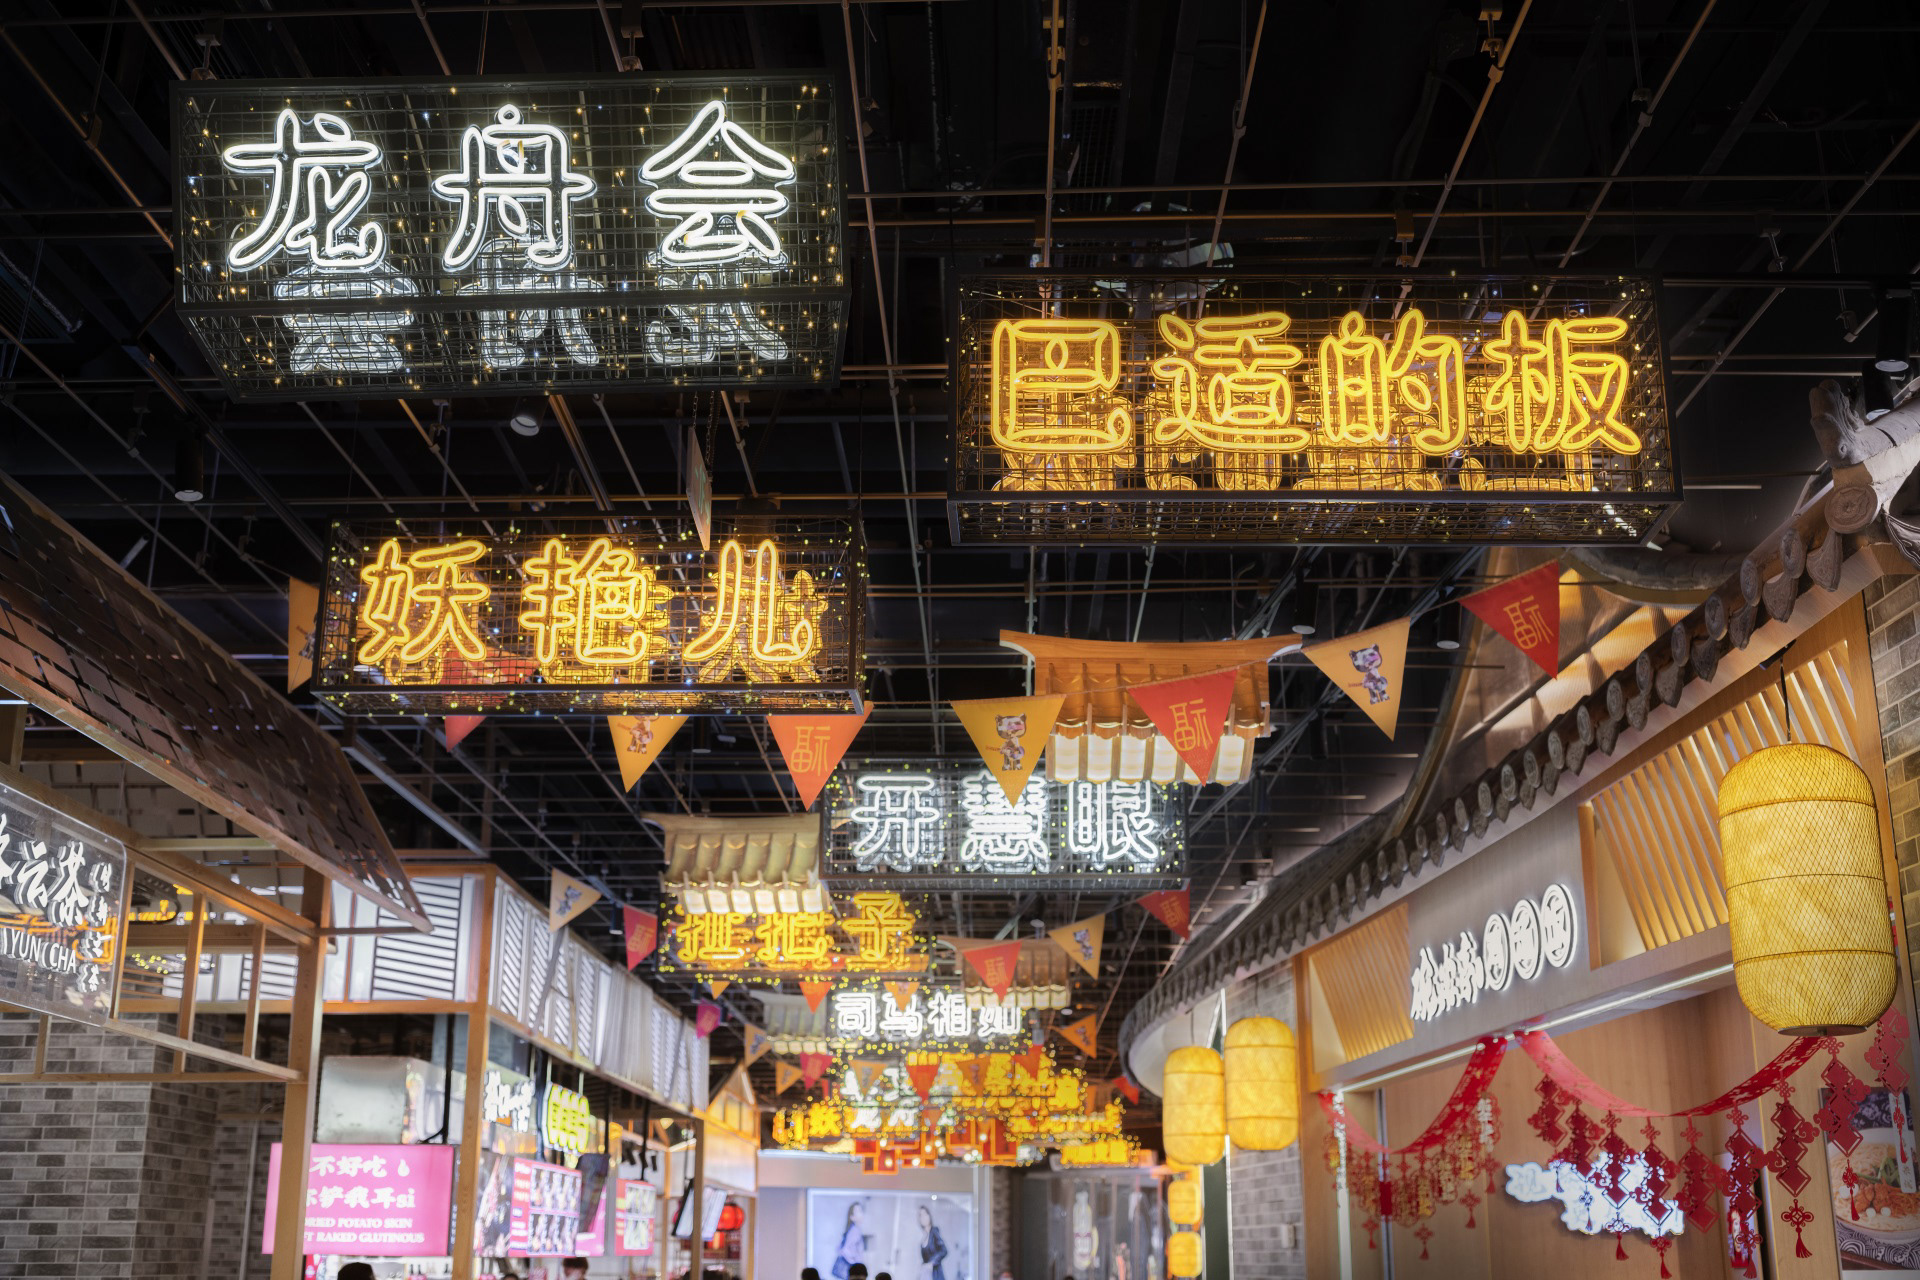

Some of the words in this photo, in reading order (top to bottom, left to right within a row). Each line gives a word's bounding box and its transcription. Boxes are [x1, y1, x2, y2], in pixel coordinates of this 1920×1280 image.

[222, 99, 798, 273] 龙舟会
[990, 308, 1644, 456] 巴适的板
[358, 536, 815, 665] 妖艳儿
[850, 770, 1160, 862] 开慧眼
[834, 991, 1022, 1038] 司马相如
